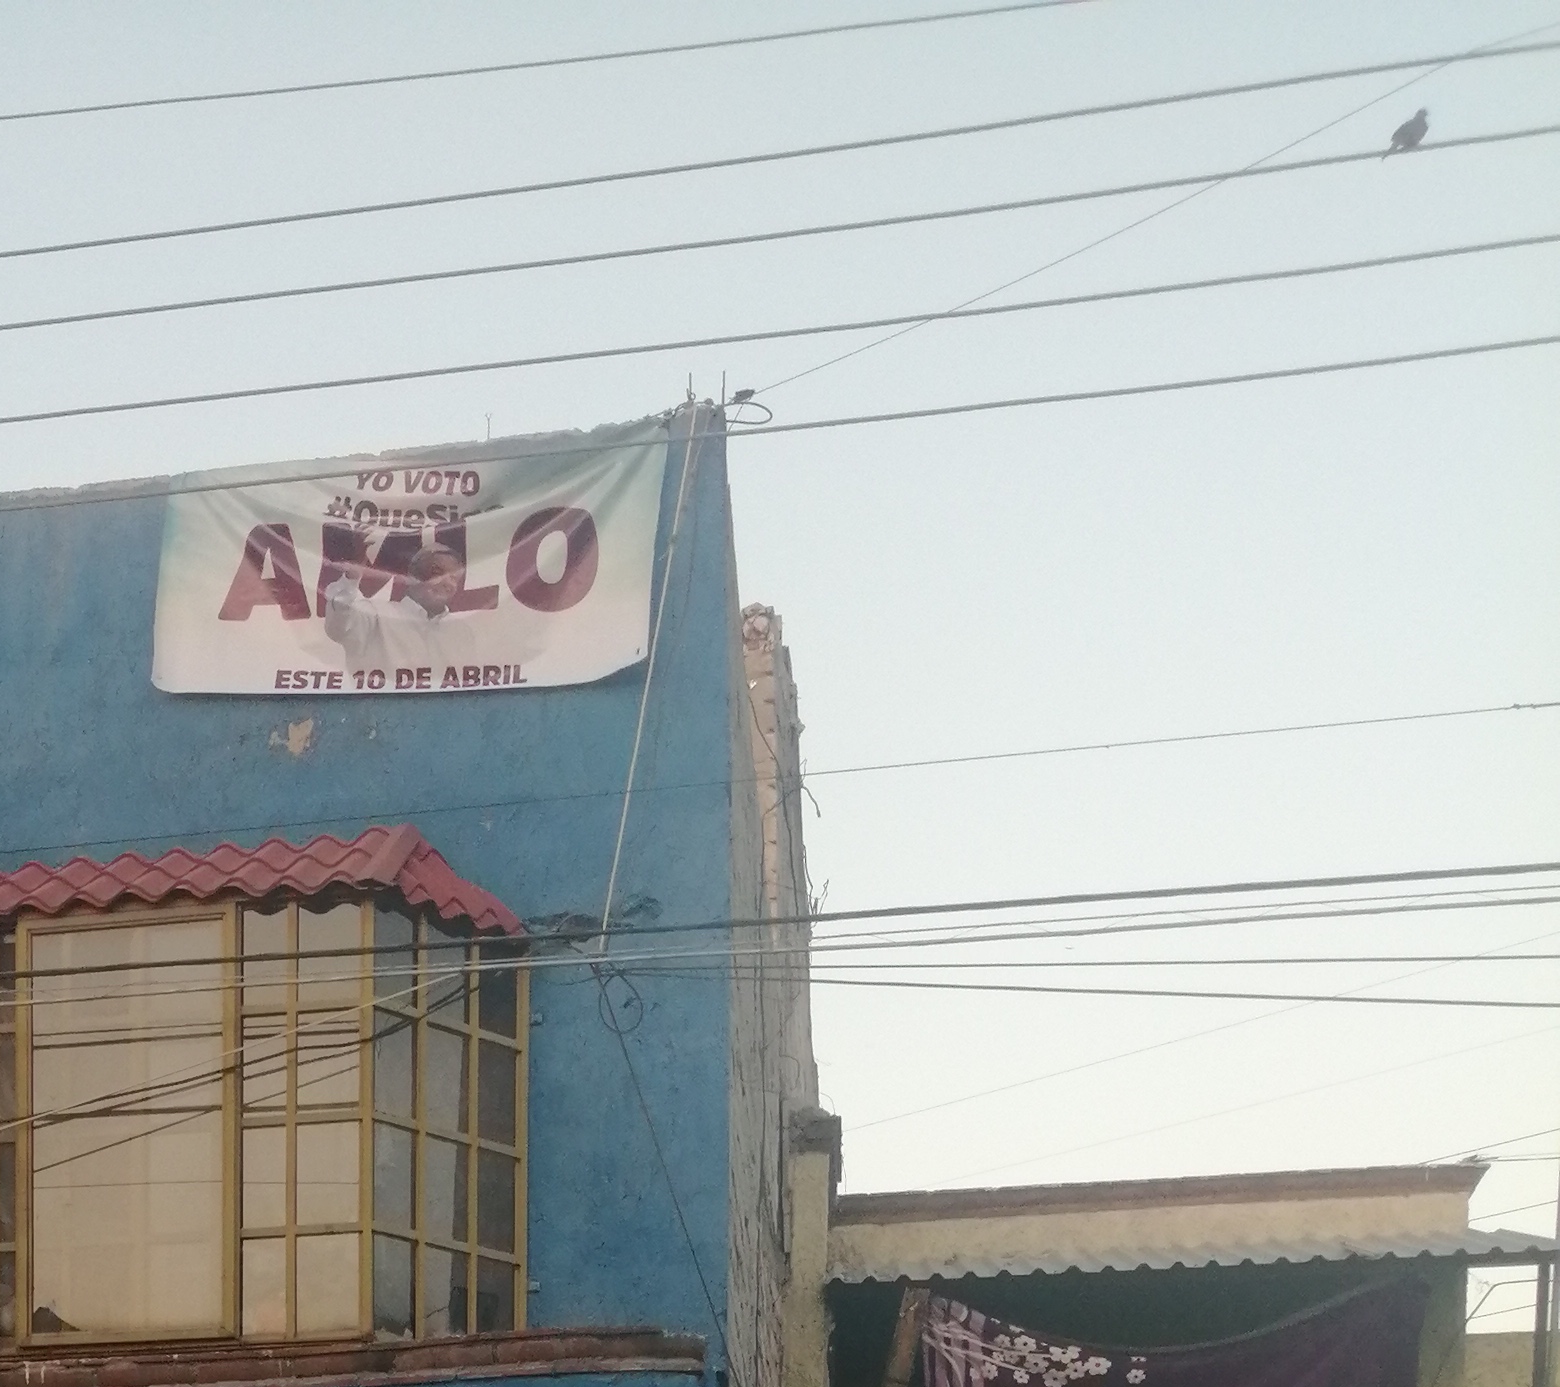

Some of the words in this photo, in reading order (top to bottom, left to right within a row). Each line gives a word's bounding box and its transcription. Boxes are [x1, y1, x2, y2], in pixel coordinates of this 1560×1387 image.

[356, 471, 394, 492] YO
[403, 470, 481, 497] VOTO
[218, 506, 599, 621] AMLO
[274, 668, 344, 690] ESTE
[352, 669, 387, 690] 10
[395, 667, 432, 690] DE
[440, 664, 529, 689] ABRIL
